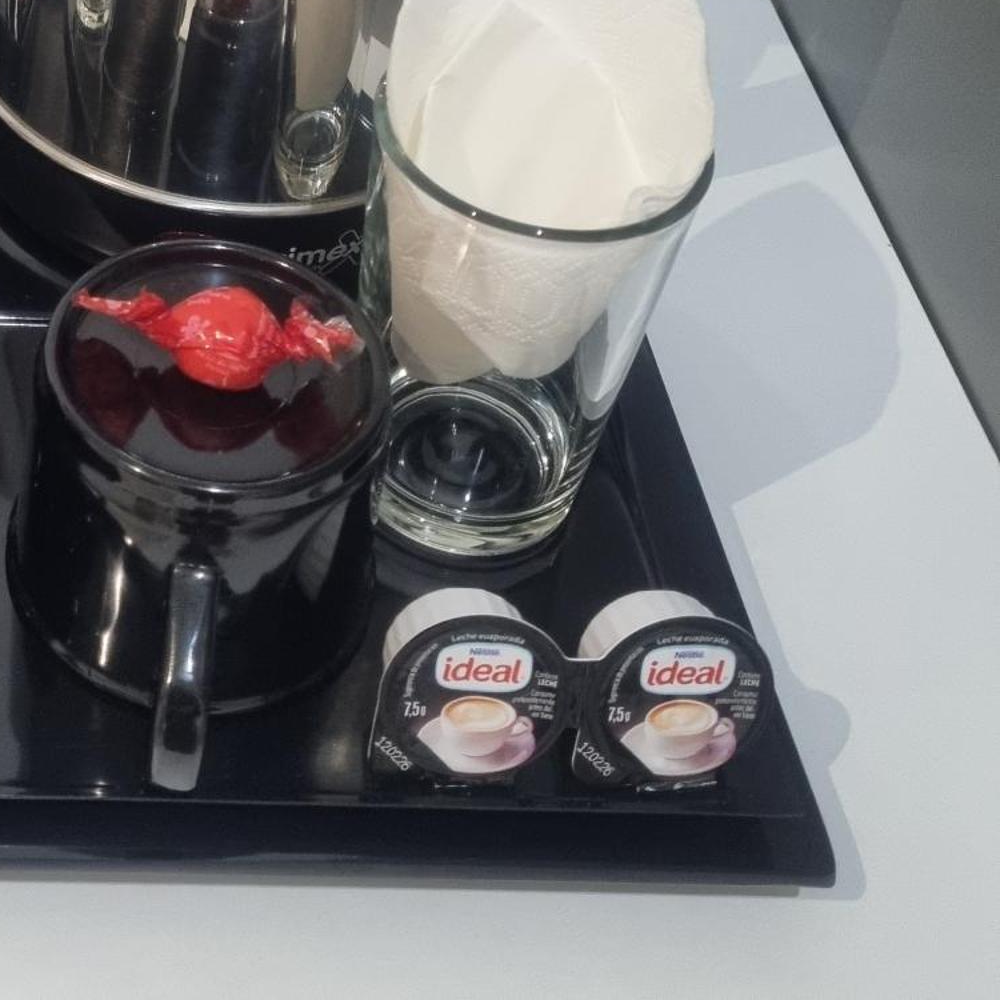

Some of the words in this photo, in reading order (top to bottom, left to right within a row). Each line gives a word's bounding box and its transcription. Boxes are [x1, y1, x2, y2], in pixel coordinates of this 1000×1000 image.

[442, 656, 522, 684] ideal
[647, 659, 725, 686] ideal
[374, 736, 414, 771] 120226
[577, 742, 616, 777] 120226
